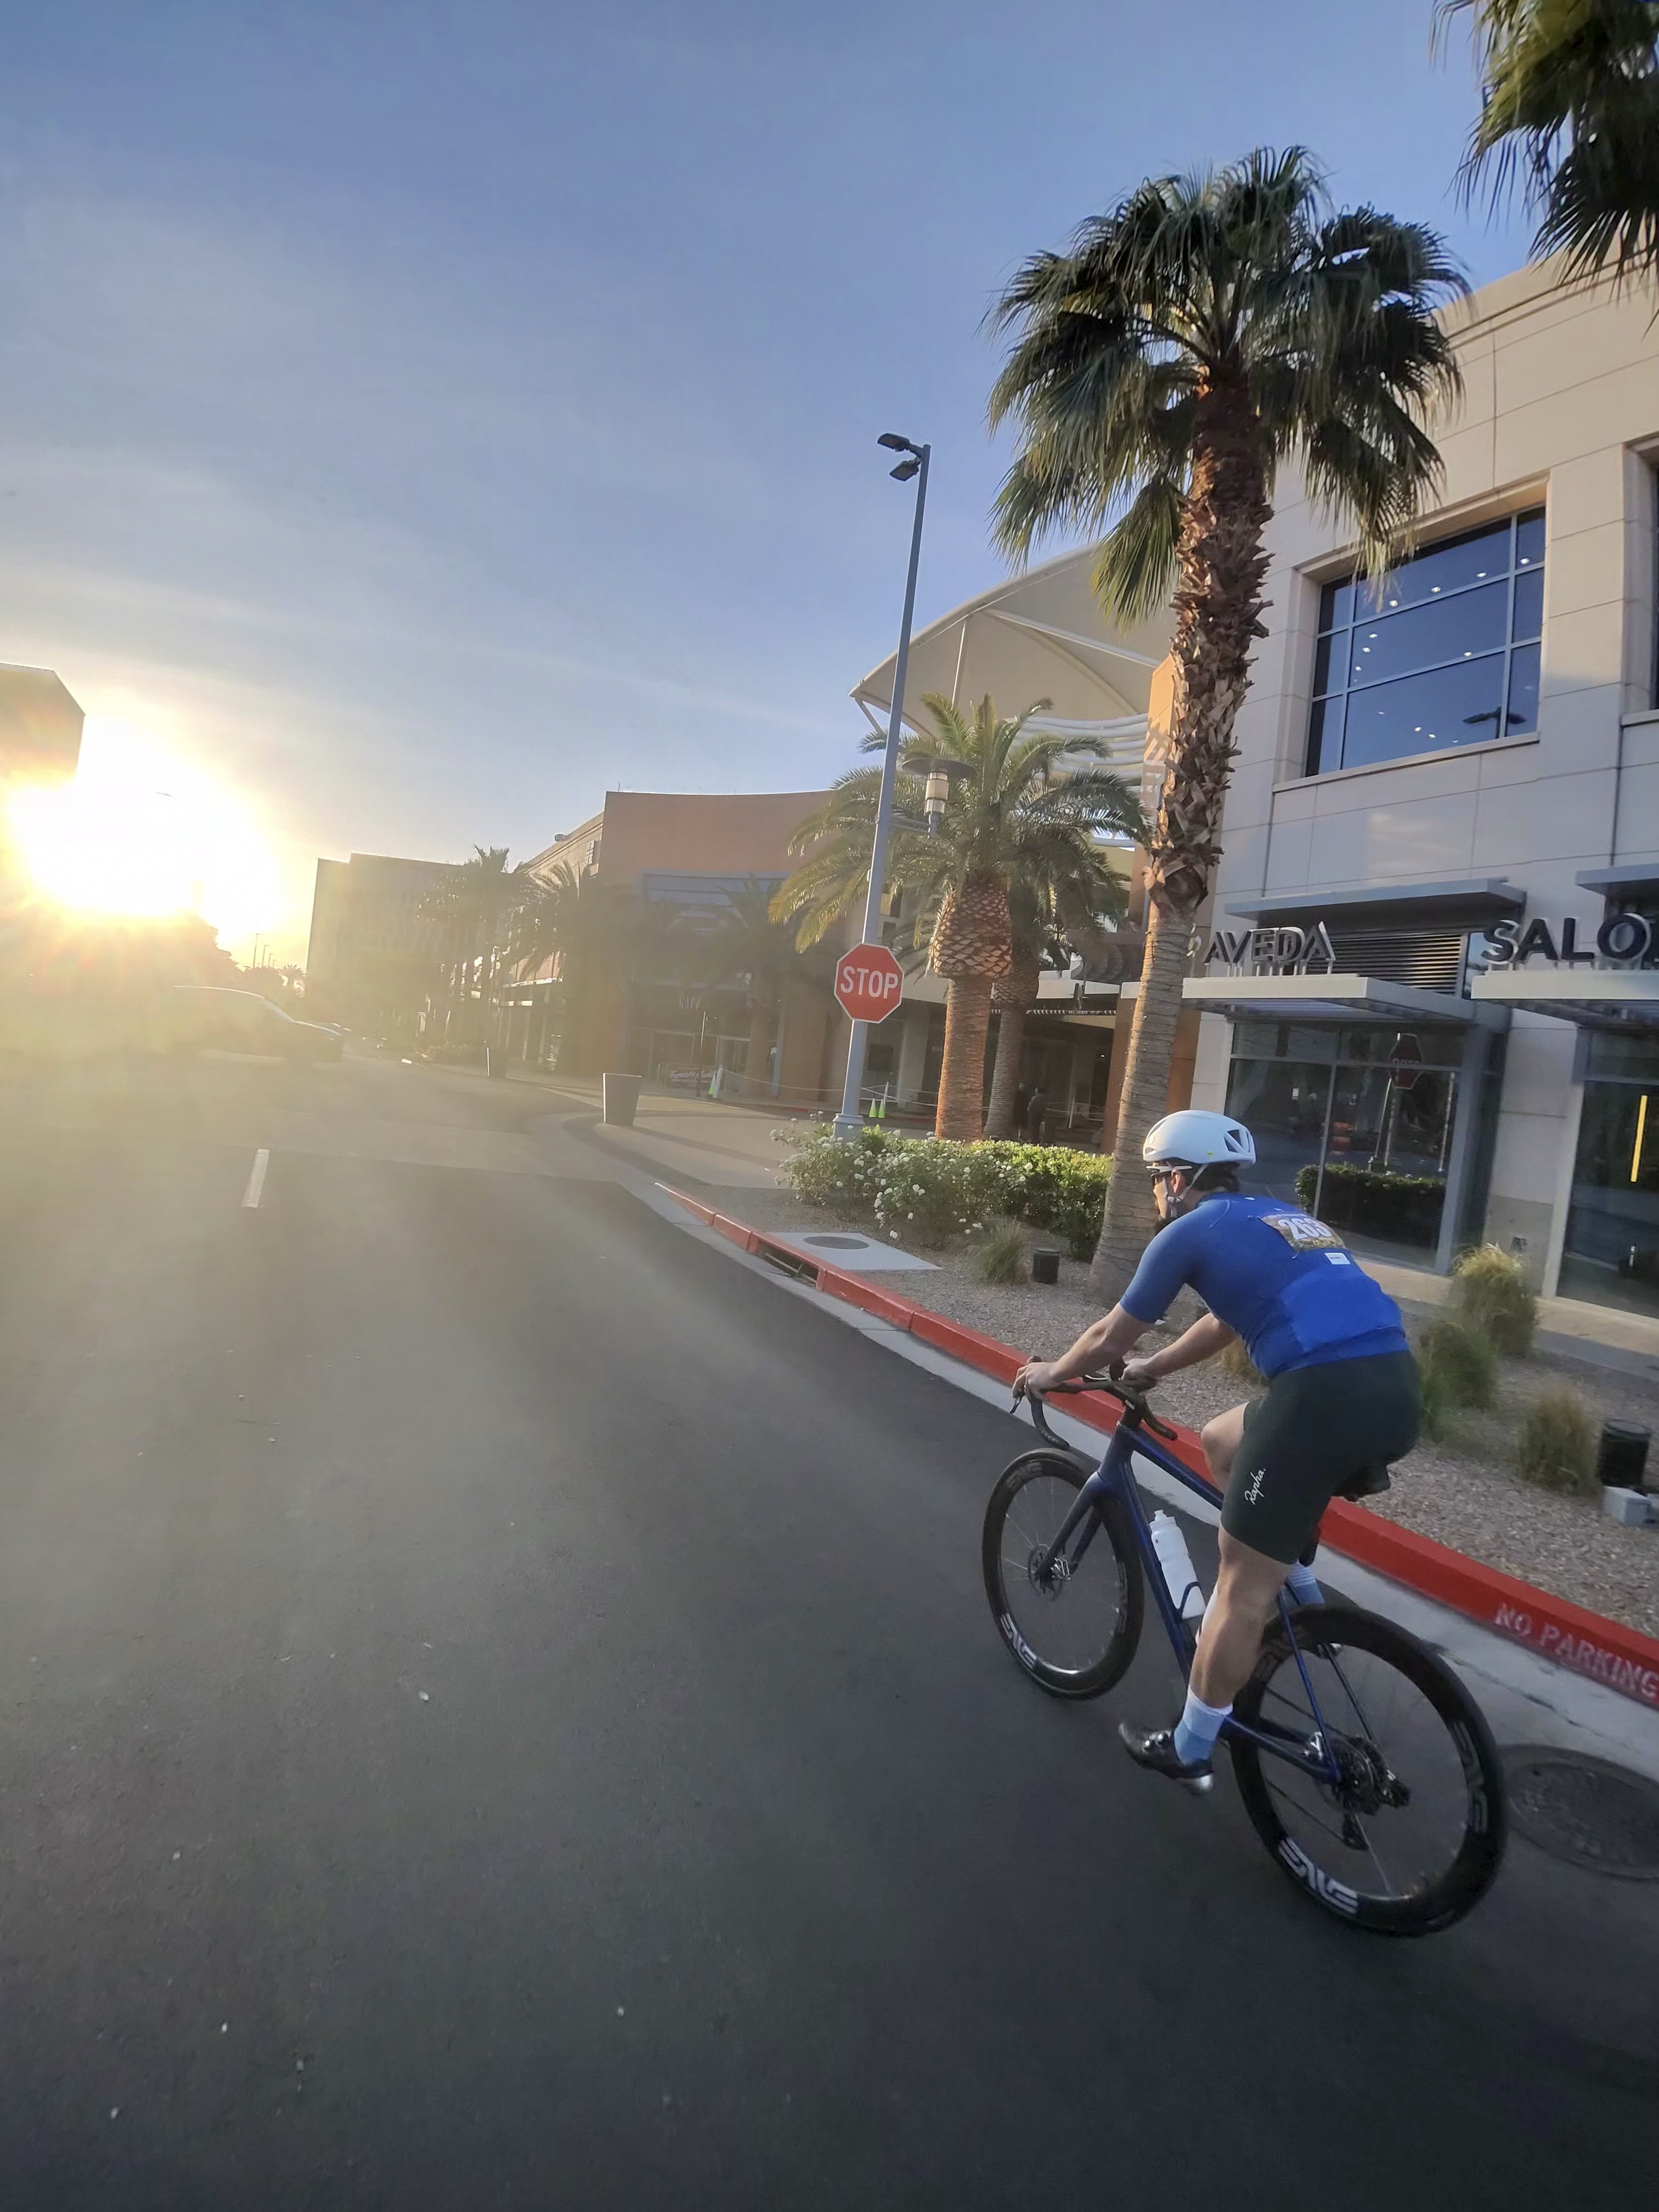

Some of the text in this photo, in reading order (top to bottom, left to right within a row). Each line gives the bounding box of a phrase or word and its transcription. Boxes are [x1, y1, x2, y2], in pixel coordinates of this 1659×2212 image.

[1204, 921, 1336, 964] AVEDA
[1481, 912, 1659, 964] SALO
[840, 966, 898, 999] STOP
[1278, 1217, 1332, 1240] 263
[1494, 1602, 1659, 1698] NO PARKING
